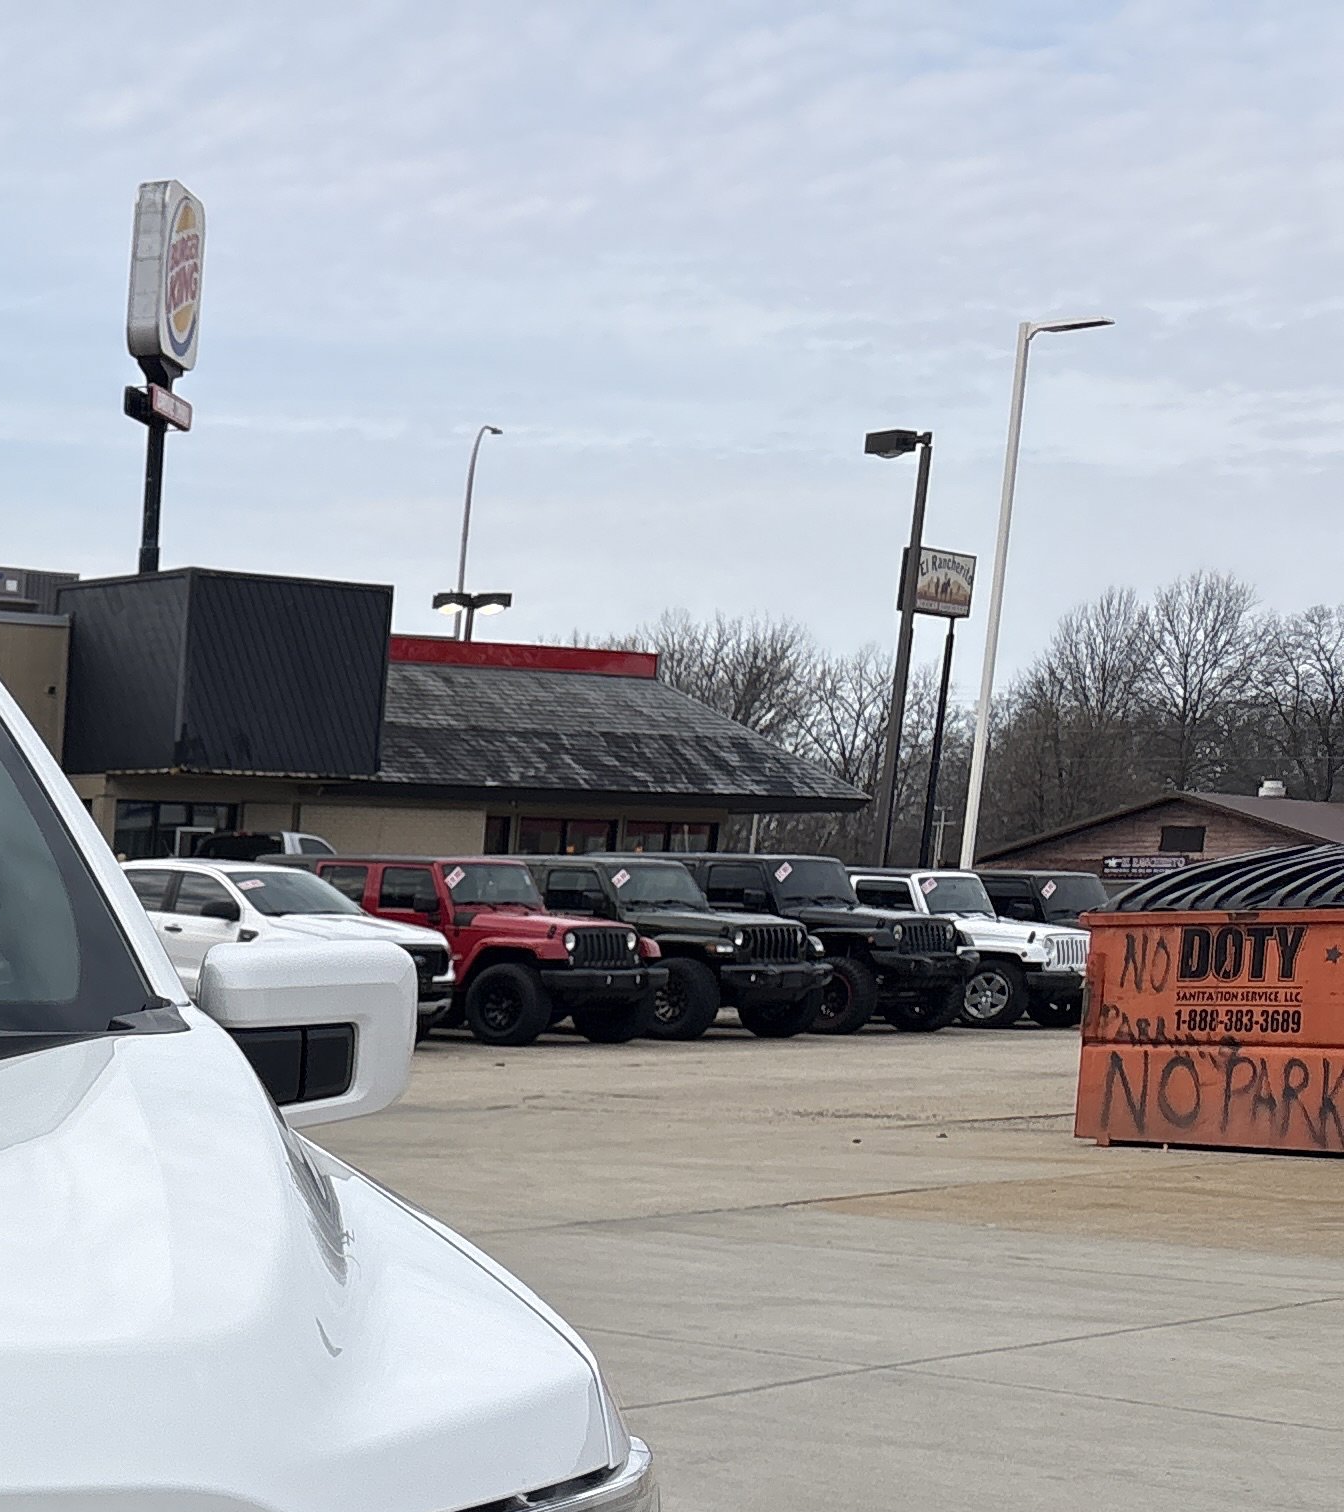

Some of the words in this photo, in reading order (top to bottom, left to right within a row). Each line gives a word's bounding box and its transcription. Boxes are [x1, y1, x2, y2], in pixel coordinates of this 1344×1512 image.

[1120, 933, 1172, 993] NO
[1177, 925, 1308, 982] DOTY
[1175, 1008, 1302, 1034] 1-888-383-3689
[1176, 991, 1239, 1003] SANITATION
[1101, 1050, 1201, 1136] NO
